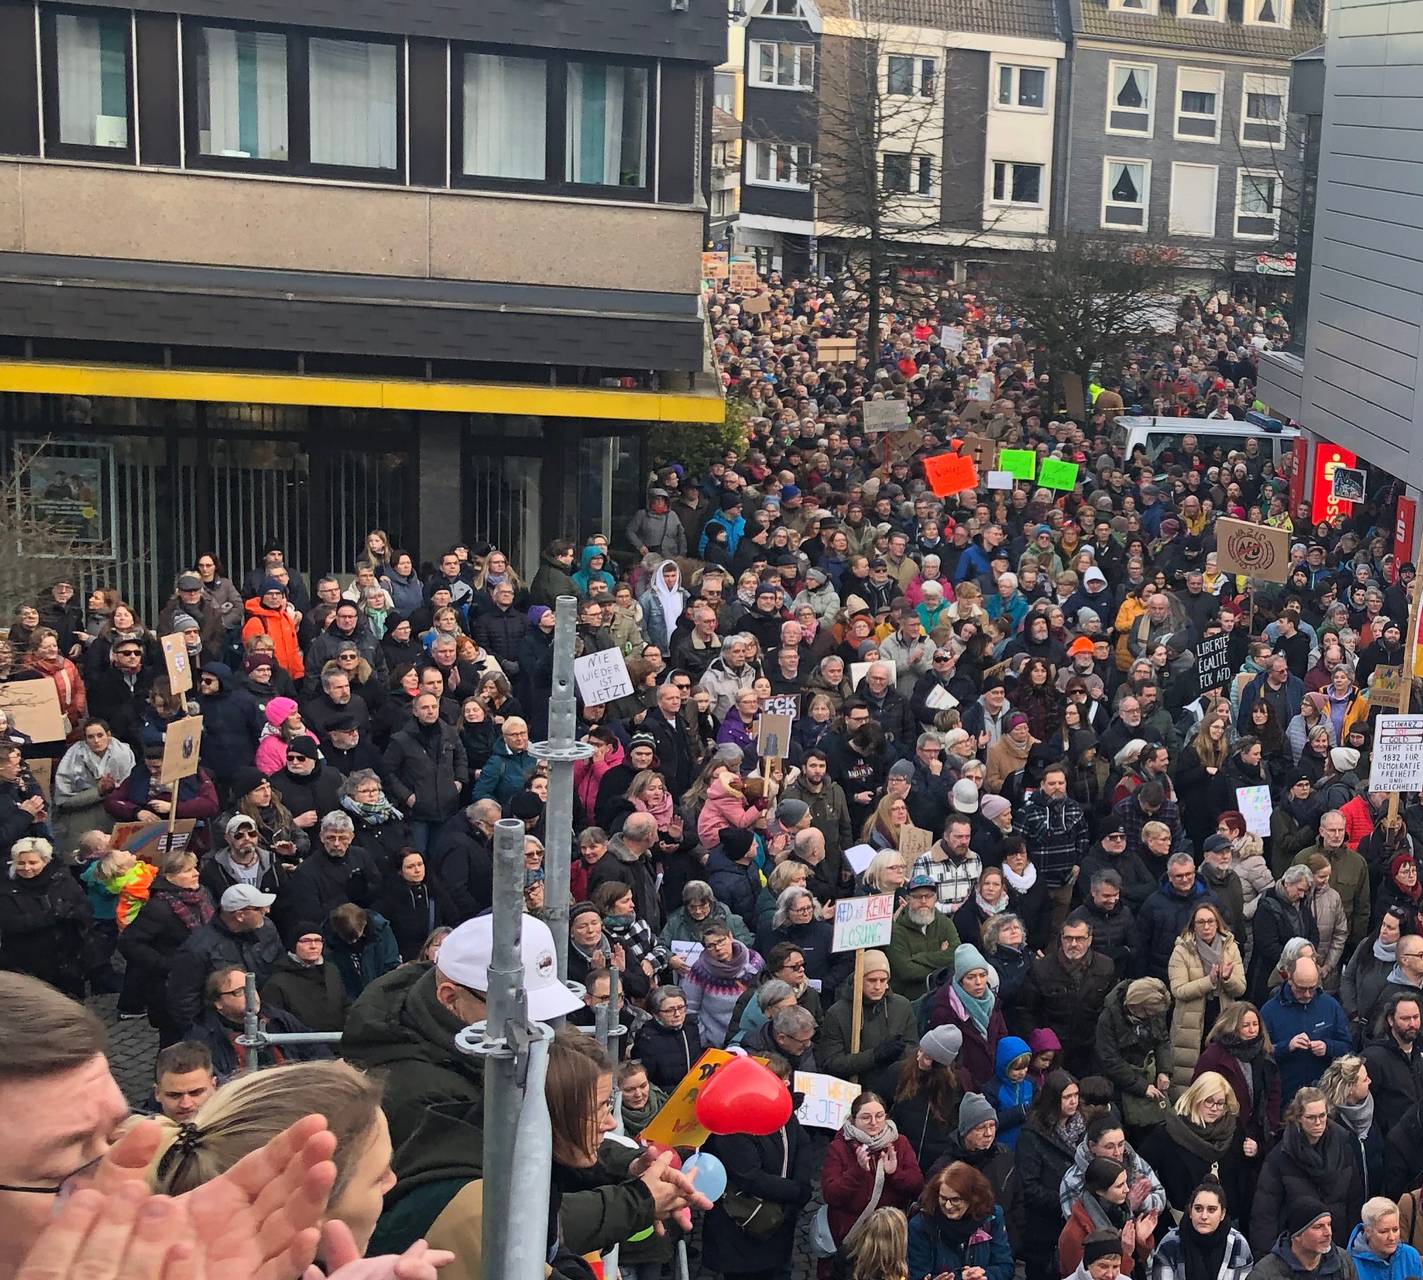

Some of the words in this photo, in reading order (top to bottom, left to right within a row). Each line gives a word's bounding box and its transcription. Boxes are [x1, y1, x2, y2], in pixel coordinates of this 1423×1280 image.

[588, 653, 609, 668] NIE
[582, 664, 620, 681] WIEDER
[600, 677, 612, 687] IST
[1200, 672, 1213, 689] FCK
[592, 683, 626, 703] JETZT
[764, 696, 797, 710] FCK
[1386, 721, 1417, 729] SCHWARZ
[1389, 736, 1409, 744] GOLD
[1380, 744, 1401, 752] STEHT
[1406, 744, 1423, 752] SEIT
[1383, 753, 1400, 761] 1832
[1405, 753, 1419, 761] FÜR
[1377, 762, 1420, 770] DEMOKRATIE
[1374, 783, 1419, 791] GLEICHHEIT
[866, 896, 892, 918] KEINE
